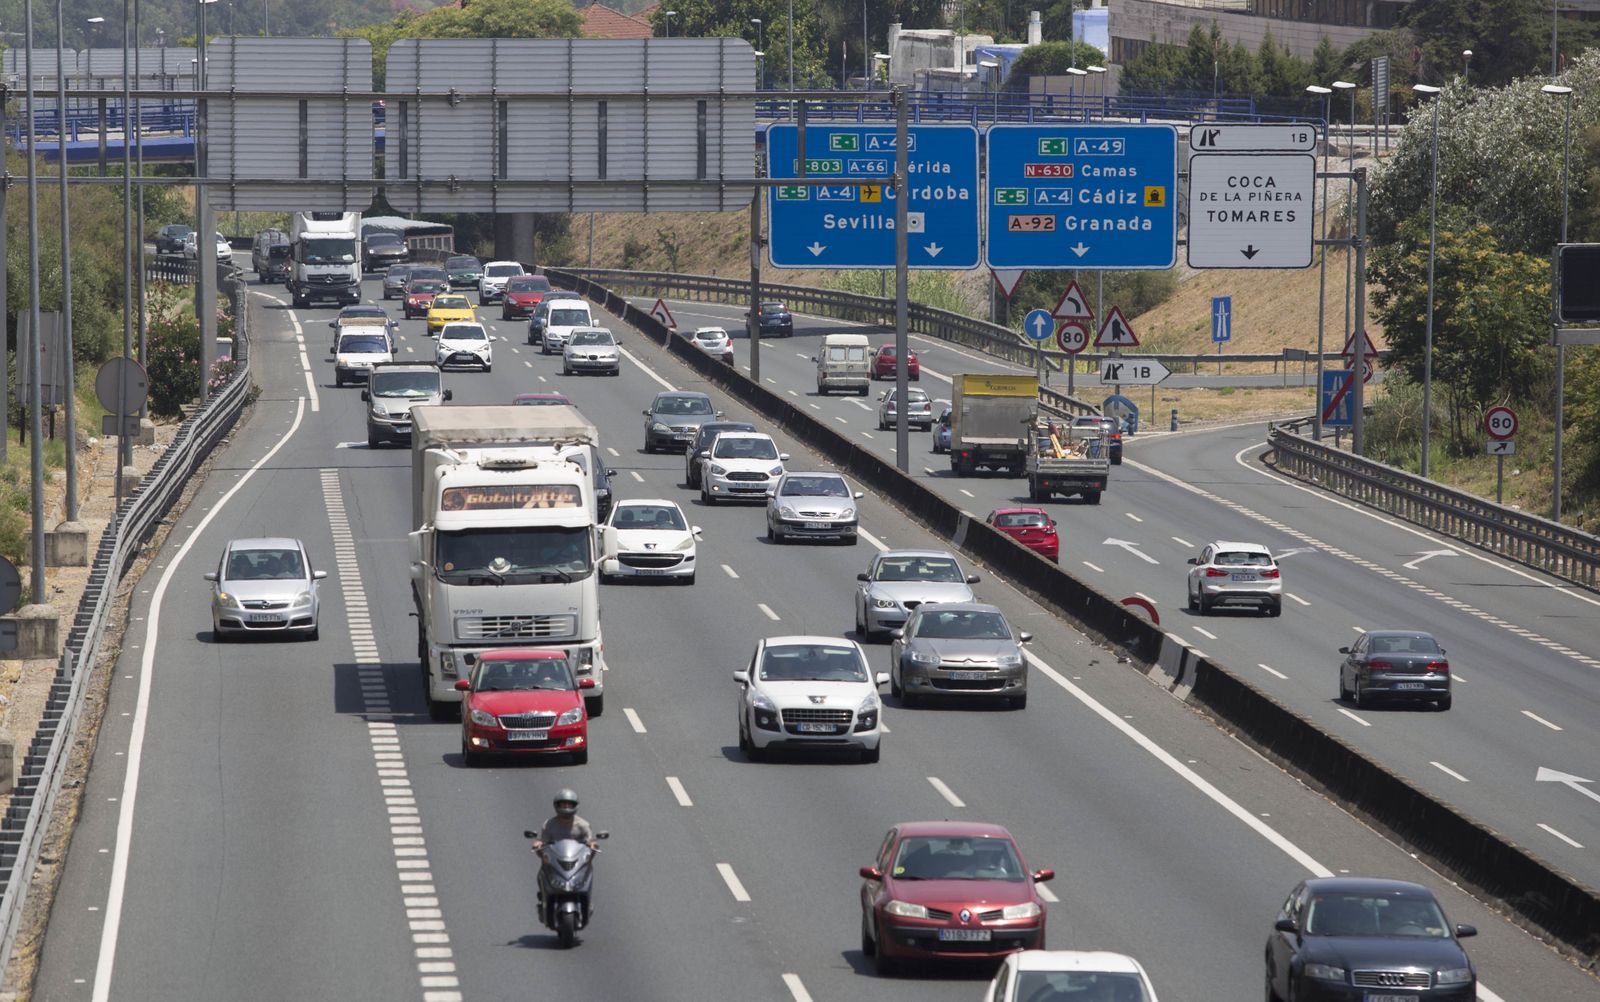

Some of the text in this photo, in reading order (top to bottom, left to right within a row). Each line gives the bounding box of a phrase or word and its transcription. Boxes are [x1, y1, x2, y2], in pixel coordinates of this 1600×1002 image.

[832, 136, 857, 149] E-1
[1291, 133, 1308, 143] 1B
[1041, 141, 1122, 153] E-1 A-49
[796, 161, 951, 173] -803 A-66 érida
[1026, 164, 1137, 177] N-630 Camas
[1227, 176, 1276, 188] COCA
[779, 185, 969, 200] E-5 A-4 Crdoba
[997, 189, 1137, 204] E-5 A-4 Cádiz
[1200, 190, 1302, 201] DE LA PIÑERA
[823, 213, 895, 229] Sevilla
[1207, 210, 1296, 222] TOMARES
[1010, 215, 1152, 231] A-92 Granada
[1063, 332, 1083, 343] 80
[1133, 367, 1151, 378] 1B
[1492, 417, 1511, 429] 80
